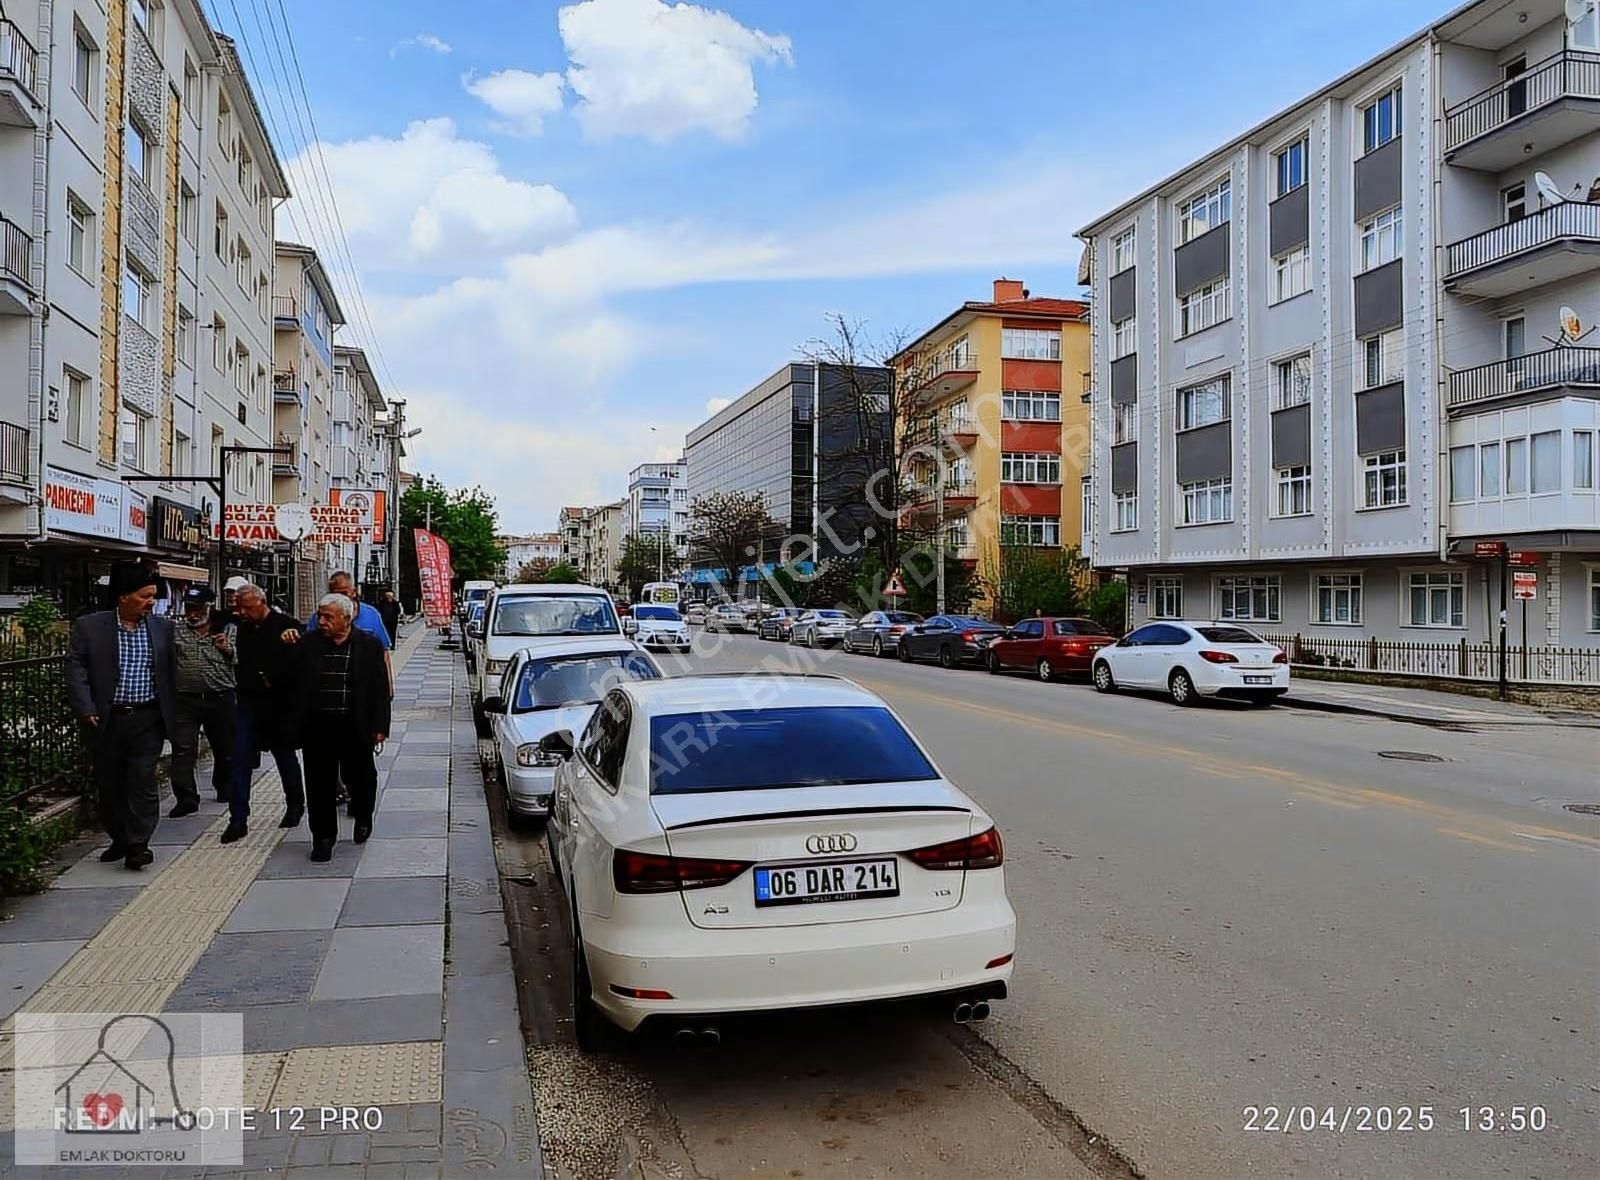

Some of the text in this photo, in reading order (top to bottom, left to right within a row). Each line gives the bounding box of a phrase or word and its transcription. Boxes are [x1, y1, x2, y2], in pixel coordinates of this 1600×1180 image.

[224, 504, 279, 513] MUTFA
[309, 507, 368, 516] AMINAT
[164, 504, 182, 541] HTC
[214, 523, 285, 540] FAYAN
[771, 864, 892, 896] 06 DAR 214
